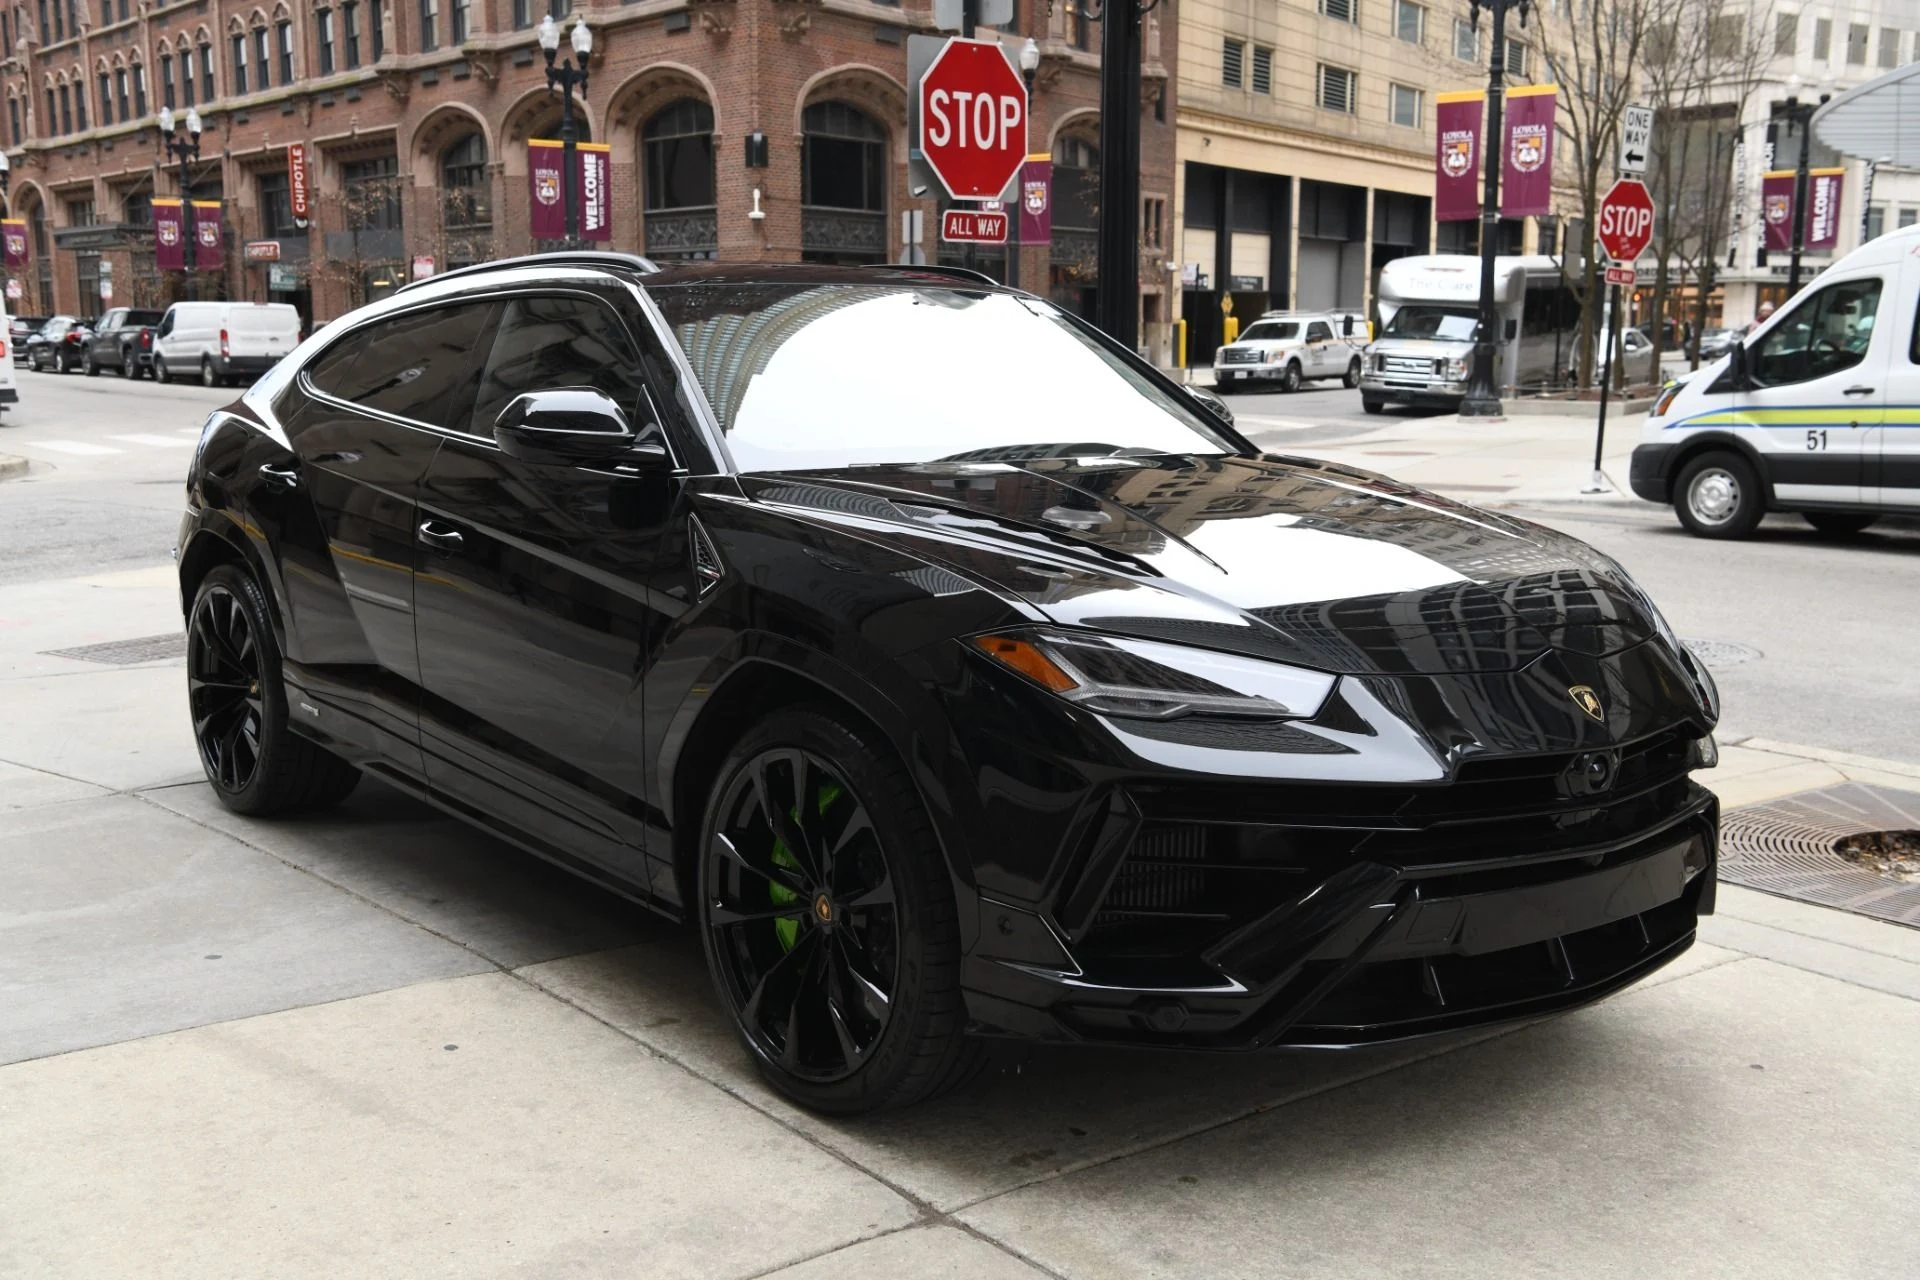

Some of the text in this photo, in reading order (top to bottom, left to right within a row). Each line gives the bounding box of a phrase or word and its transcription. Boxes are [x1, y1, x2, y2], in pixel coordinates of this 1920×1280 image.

[929, 88, 1021, 151] STOP
[1512, 124, 1547, 135] LOYOLA
[1627, 111, 1650, 128] ONE
[1442, 130, 1474, 140] LOYOLA
[1625, 130, 1648, 147] WAY
[292, 148, 306, 212] CHIPOTLE
[583, 153, 598, 230] WELCOME
[1811, 176, 1831, 242] WELCOME
[950, 218, 1002, 237] ALL WAY
[1601, 204, 1651, 238] STOP
[1608, 270, 1620, 281] ALL
[1806, 430, 1827, 451] 51
